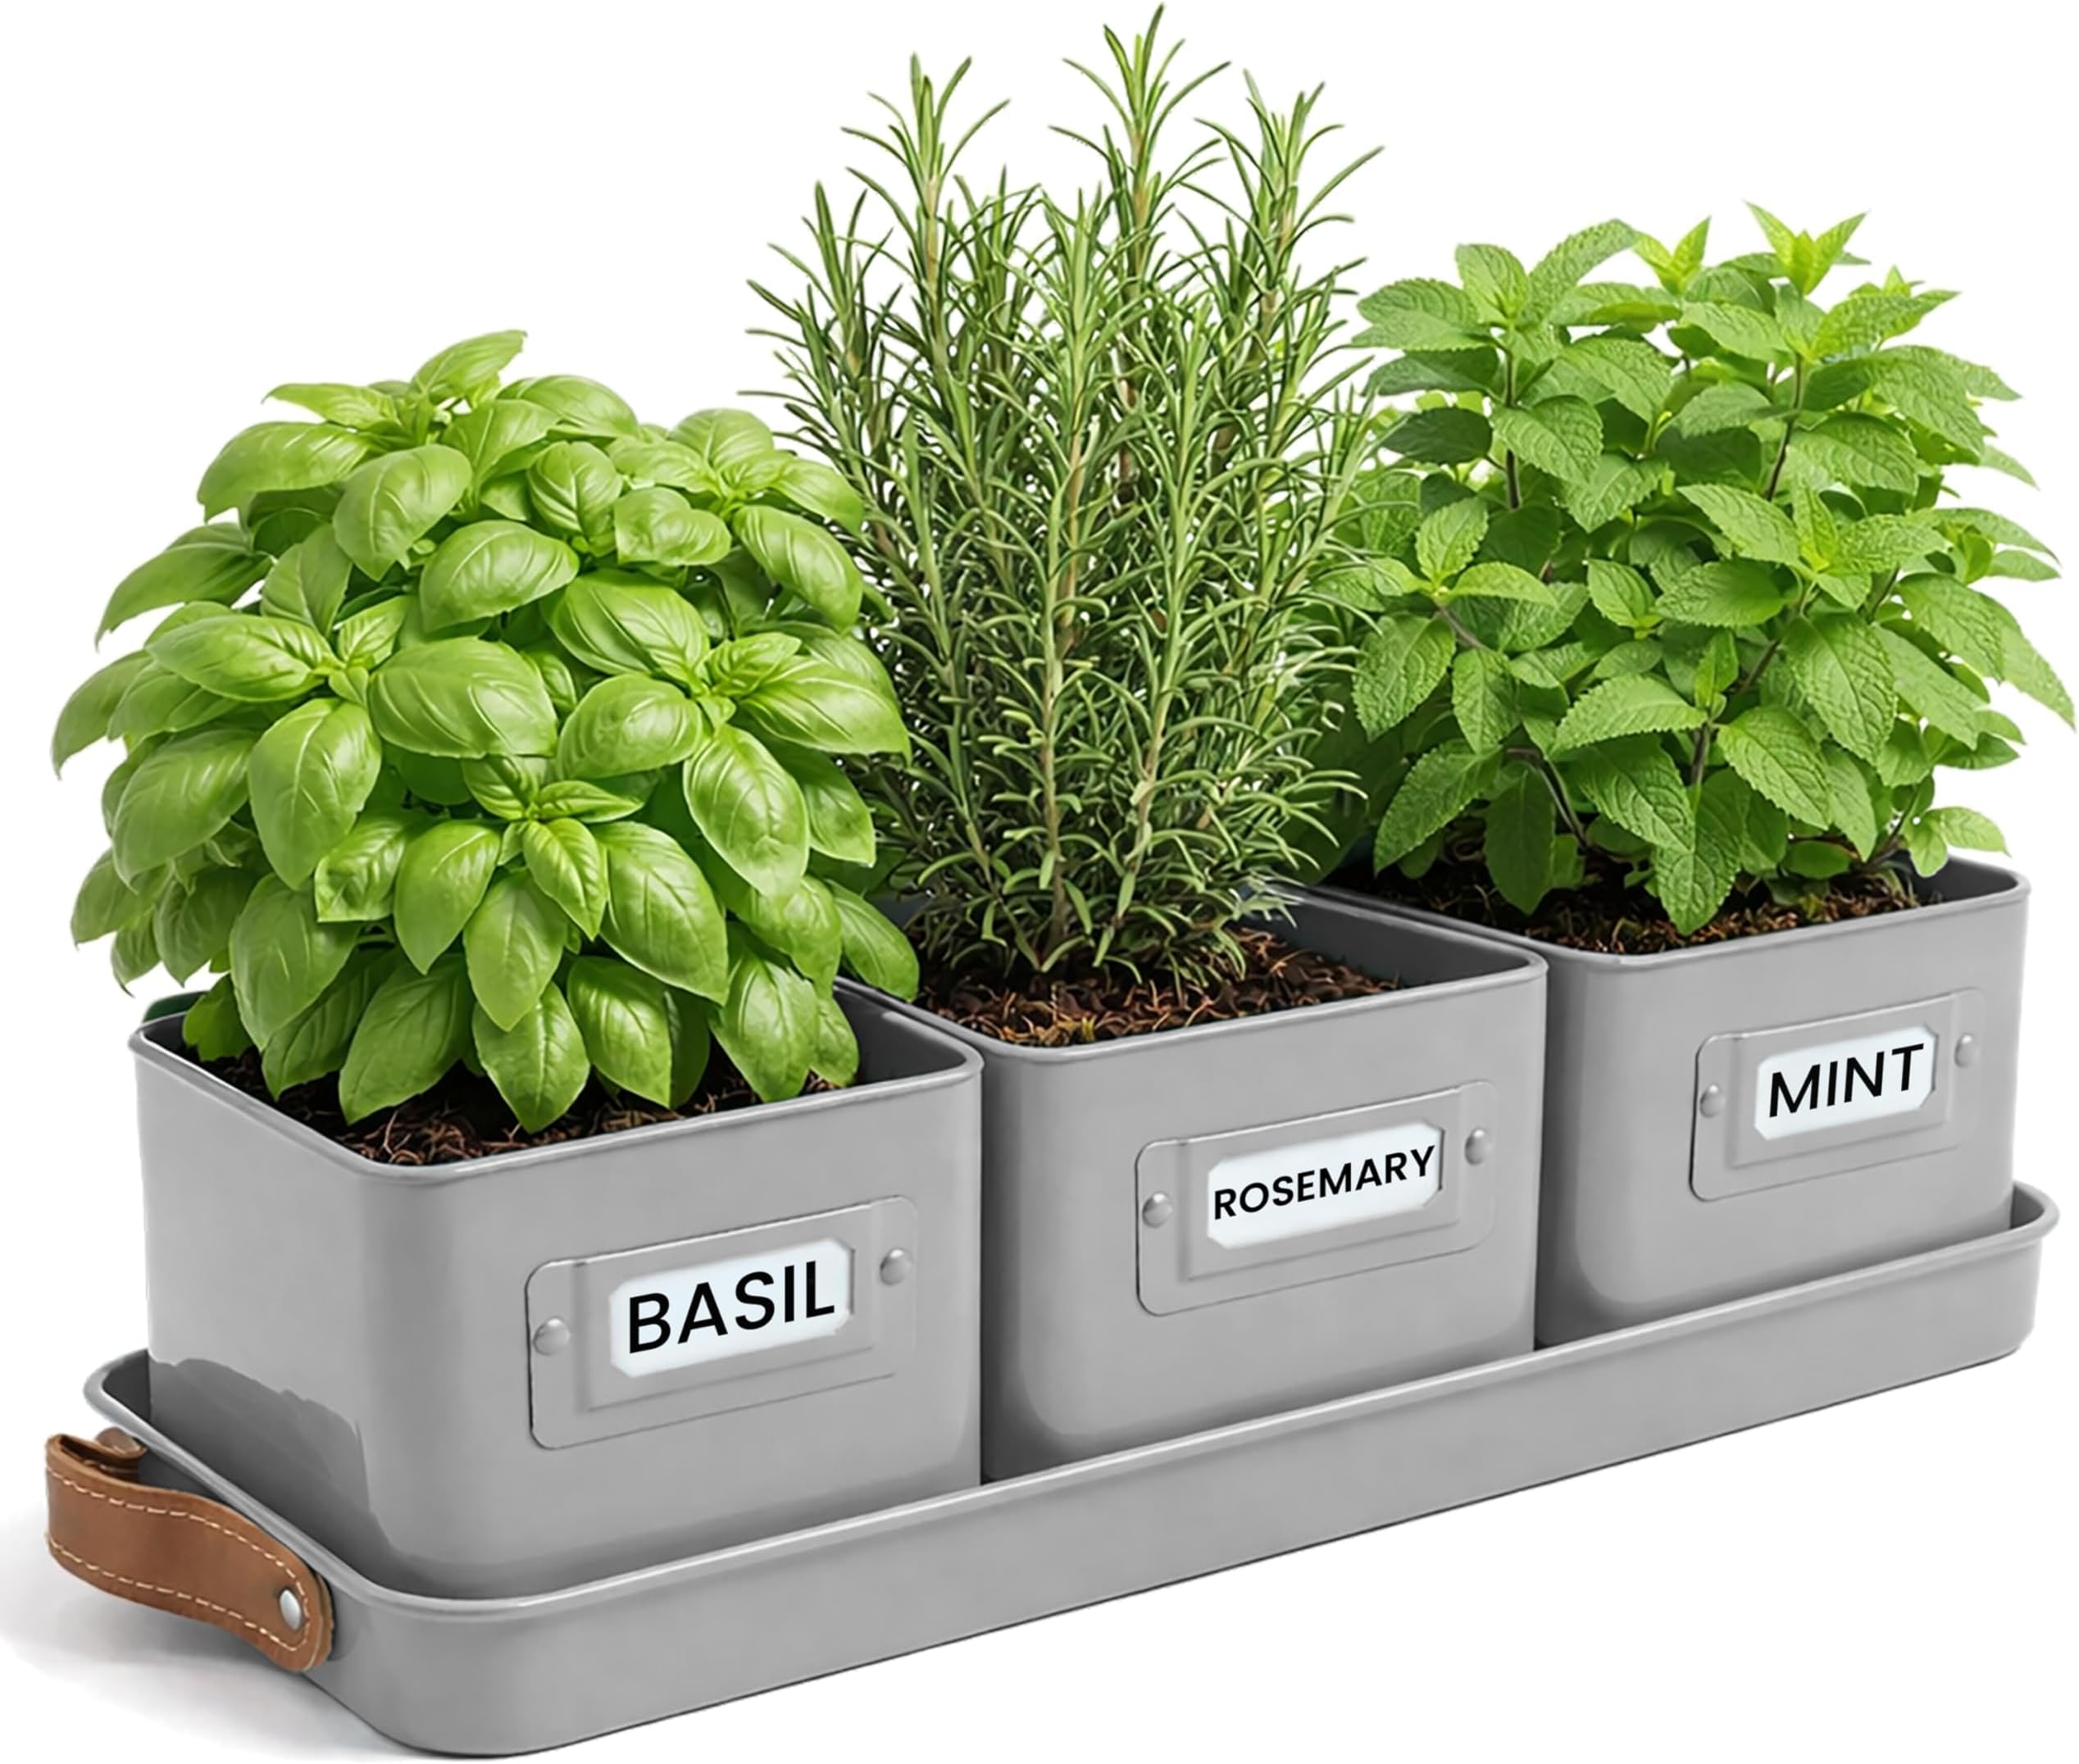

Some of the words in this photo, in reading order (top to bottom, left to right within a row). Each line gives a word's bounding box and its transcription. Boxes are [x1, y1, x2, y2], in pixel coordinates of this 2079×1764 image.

[1769, 1043, 1924, 1118] MINT
[1214, 1145, 1435, 1221] ROSEMARY
[629, 1260, 835, 1354] BASIL
